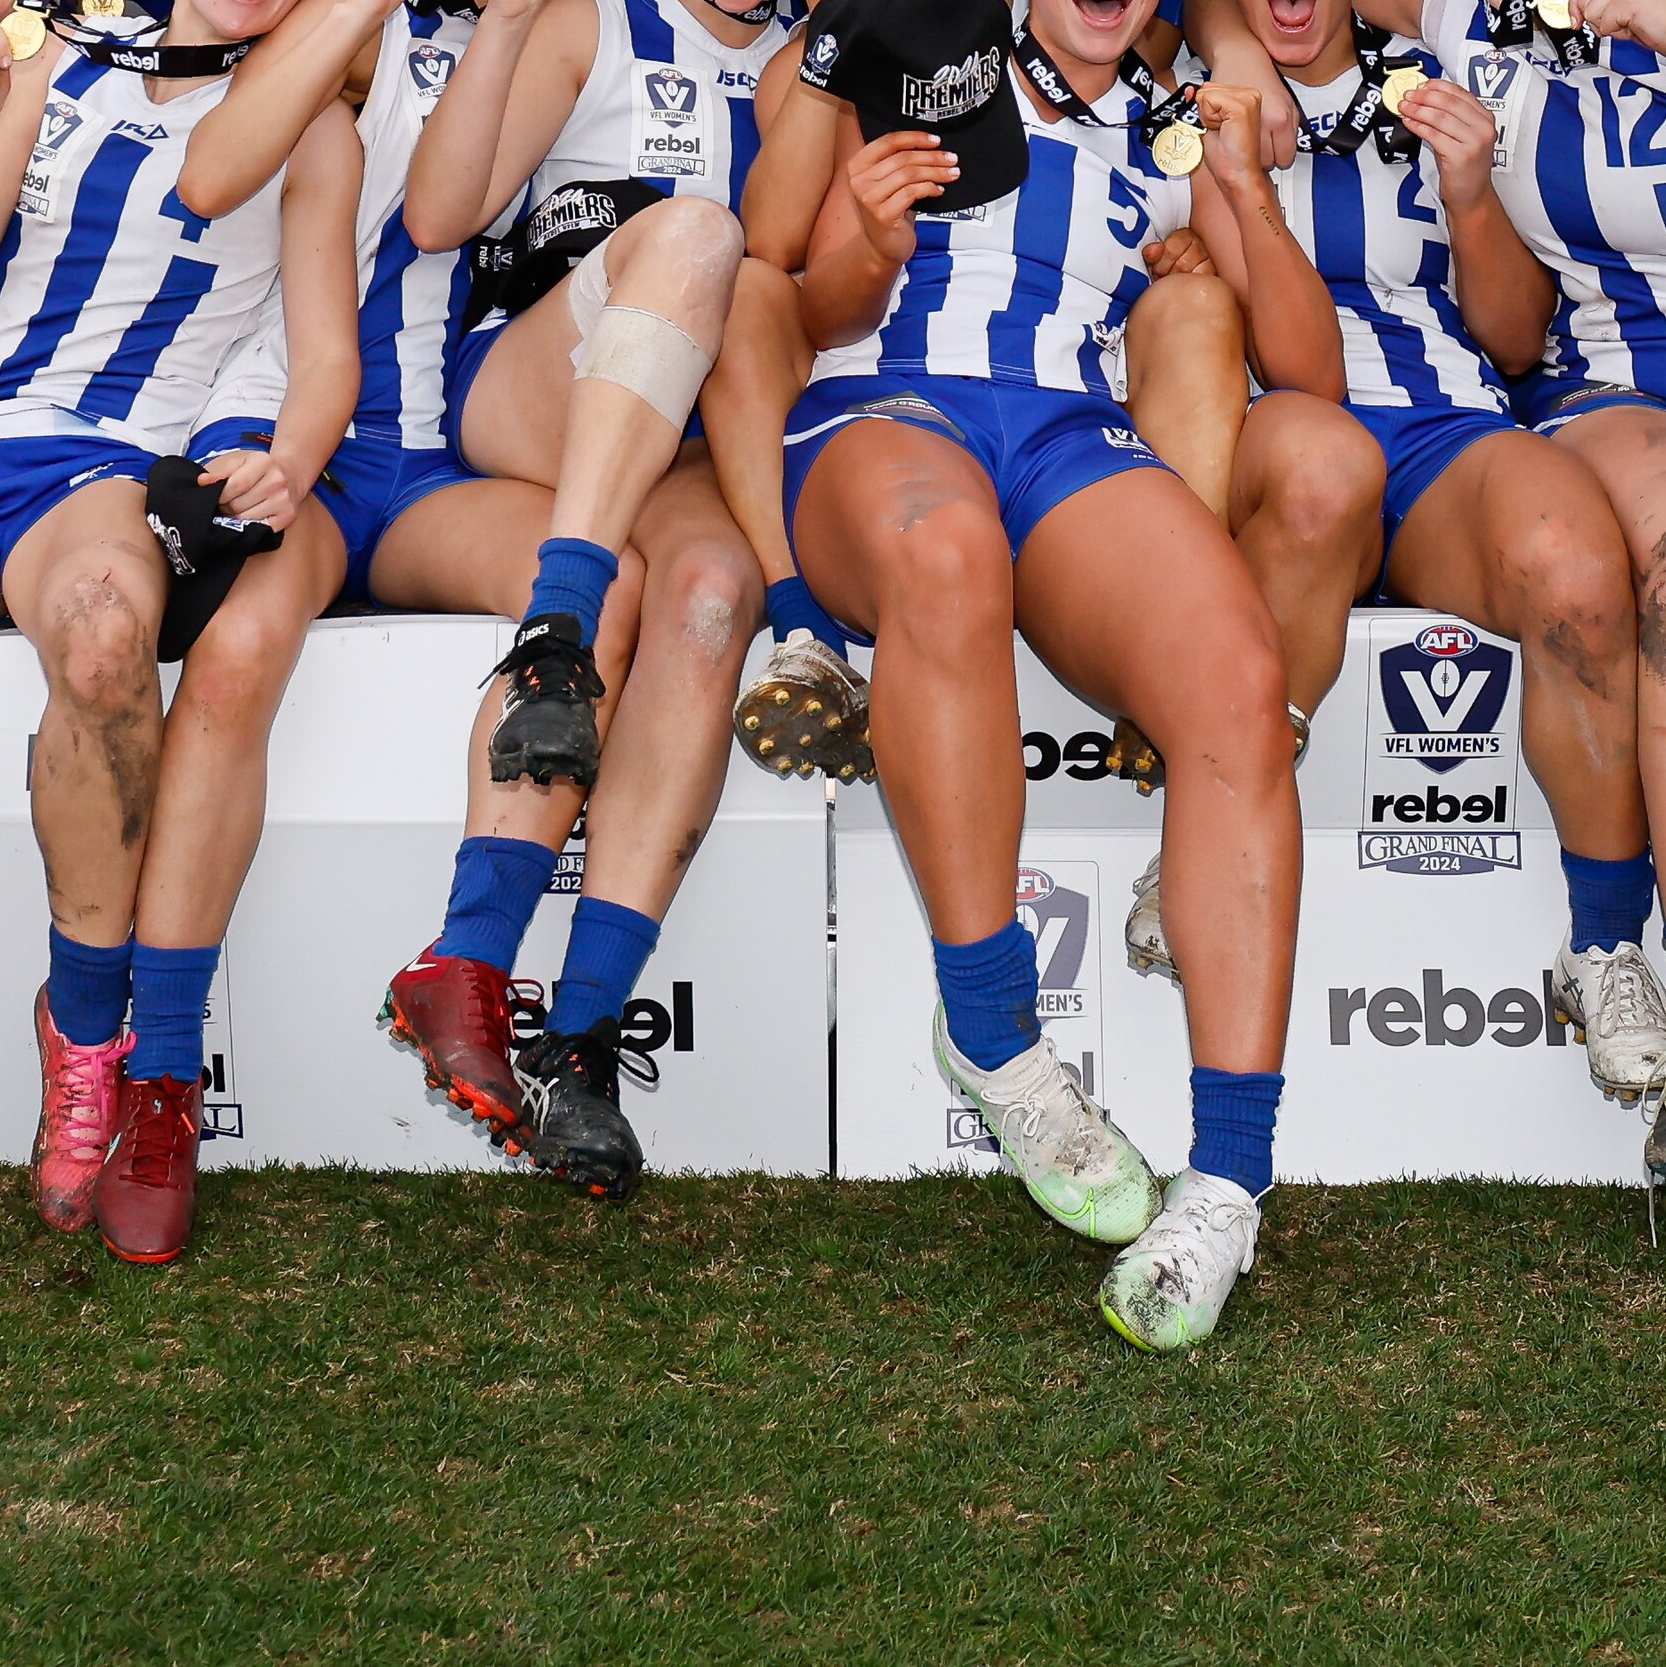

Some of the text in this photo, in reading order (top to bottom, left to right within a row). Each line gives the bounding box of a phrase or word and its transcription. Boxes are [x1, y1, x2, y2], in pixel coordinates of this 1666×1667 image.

[112, 50, 160, 71] rebel
[1026, 57, 1072, 104] rebel
[650, 110, 697, 124] VFL WOMEN'S
[1351, 81, 1384, 133] rebel
[644, 134, 701, 155] rebel
[525, 623, 550, 640] asics
[1421, 633, 1472, 651] AFL
[1386, 735, 1500, 753] VFL WOMEN'S
[1372, 786, 1506, 823] rebel
[1364, 836, 1515, 863] GRAND FINAL
[1419, 857, 1461, 872] 2024
[550, 876, 582, 890] 202
[1329, 969, 1566, 1046] rebel
